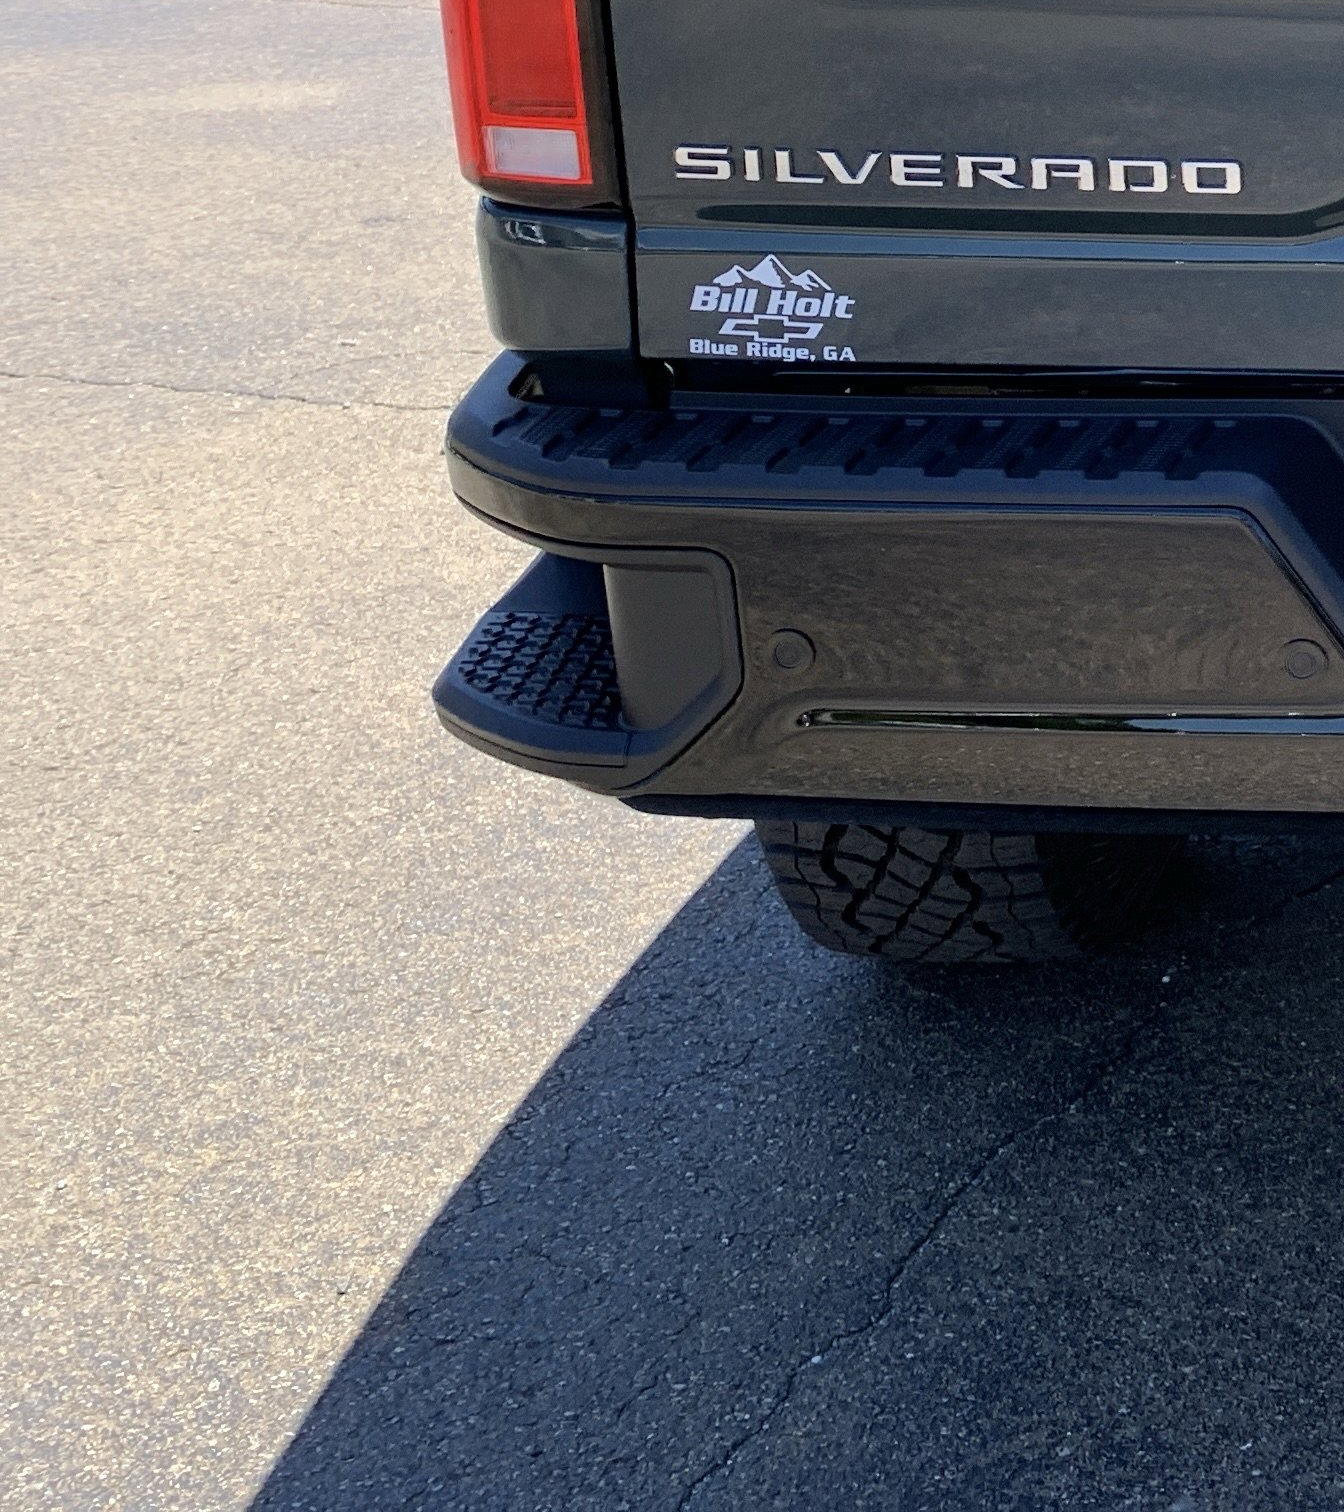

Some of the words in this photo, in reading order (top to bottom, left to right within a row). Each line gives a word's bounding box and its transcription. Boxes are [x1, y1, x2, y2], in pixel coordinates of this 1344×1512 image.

[674, 143, 1243, 194] SILVERADO
[690, 285, 759, 314] Bill
[766, 289, 856, 319] Holt
[689, 338, 739, 357] Blue
[746, 341, 816, 363] Ridge,
[823, 346, 857, 362] GA
